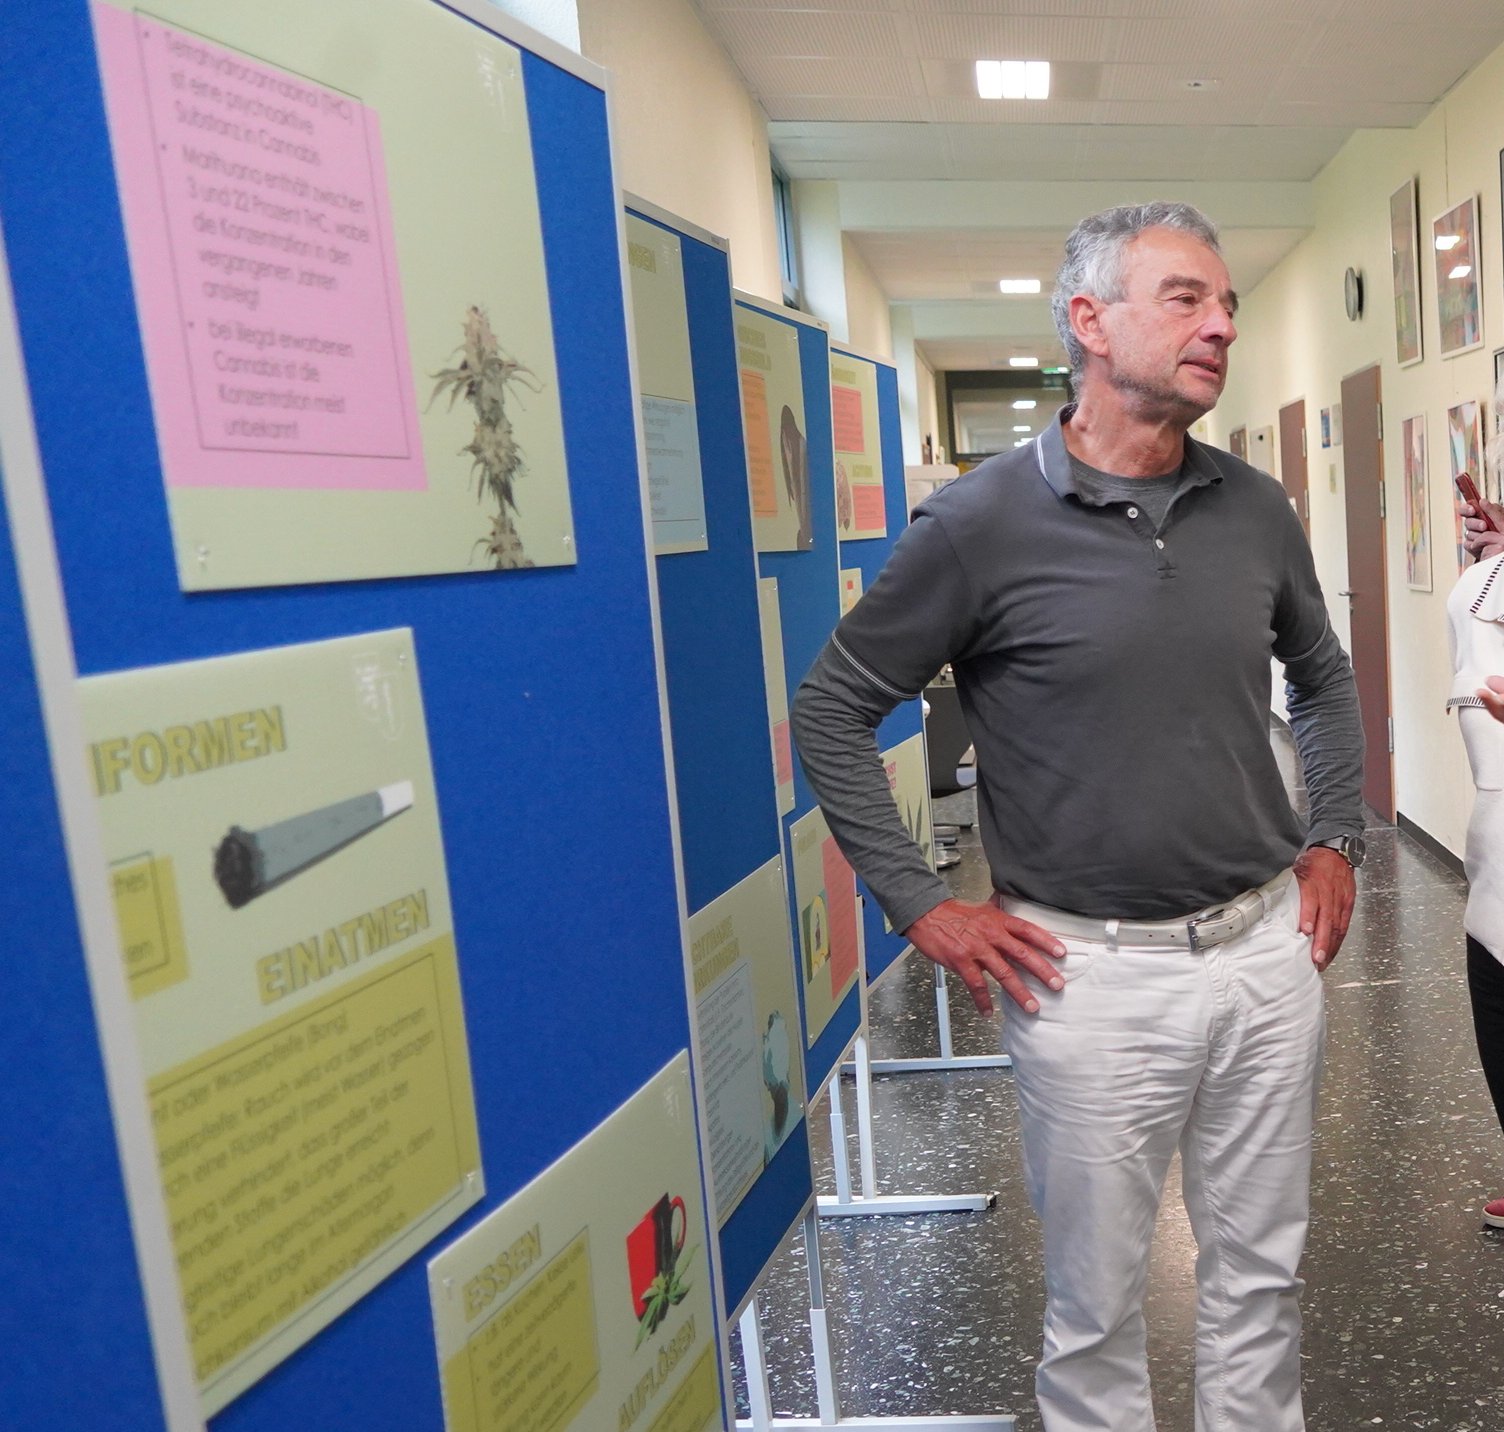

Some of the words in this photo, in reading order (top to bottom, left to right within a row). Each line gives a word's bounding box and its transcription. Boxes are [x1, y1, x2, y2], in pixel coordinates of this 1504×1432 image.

[175, 100, 241, 141] Substanz
[259, 128, 321, 166] Cannabis
[187, 175, 197, 199] 3
[202, 185, 231, 206] und
[232, 188, 250, 213] 22
[220, 217, 310, 257] Konzentration
[208, 319, 232, 341] bei
[213, 349, 282, 377] Cannabis
[218, 384, 311, 410] Konzentration
[91, 704, 288, 797] FORMEN
[254, 888, 431, 1006] EINATMEN
[462, 1222, 542, 1322] ESSEN
[617, 1313, 697, 1432] AUFLÖSEN
